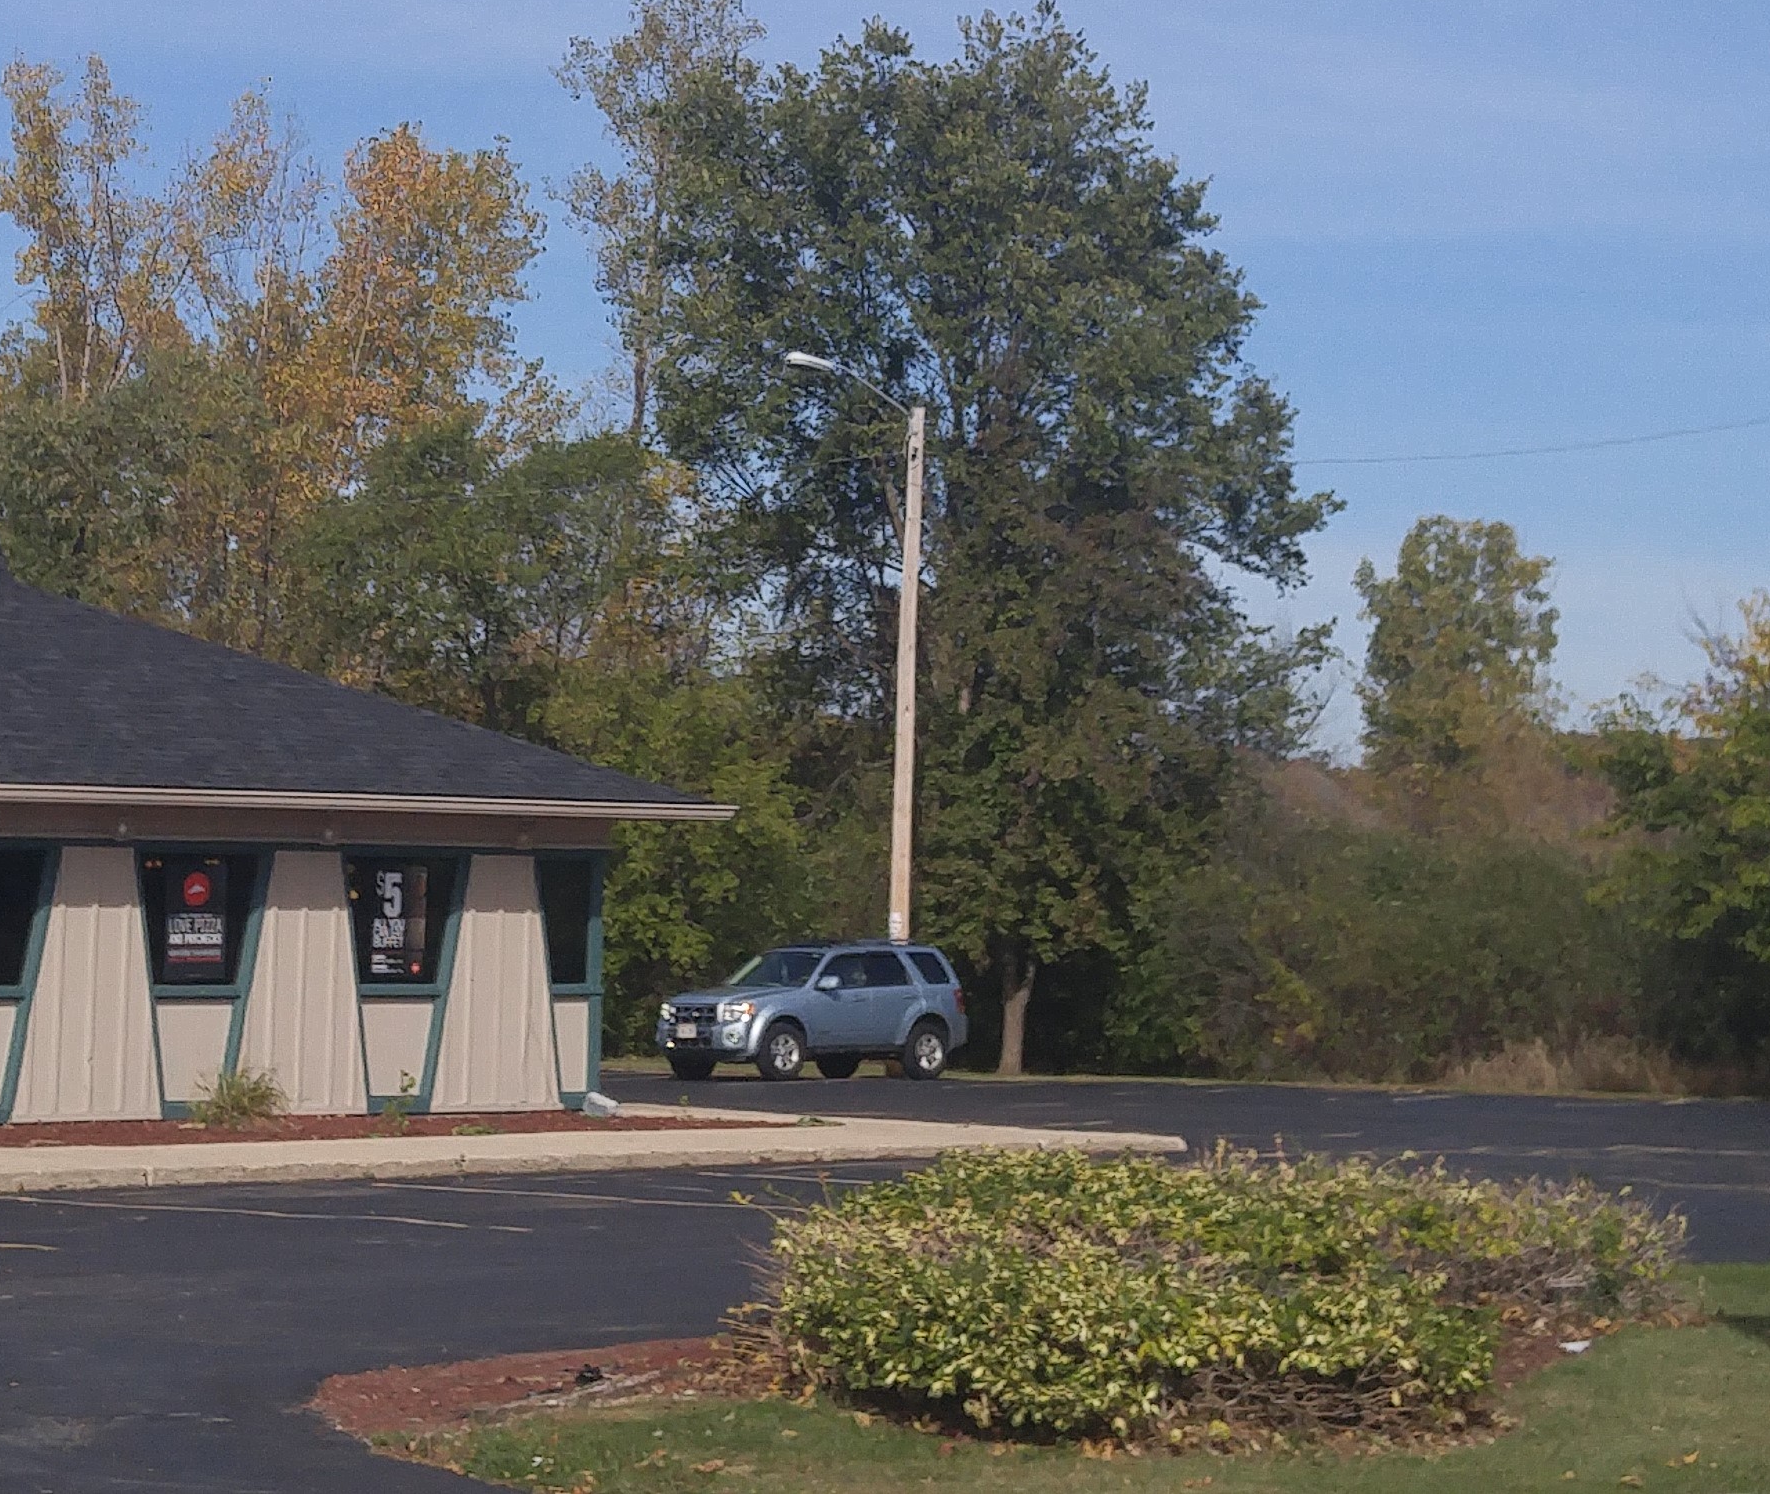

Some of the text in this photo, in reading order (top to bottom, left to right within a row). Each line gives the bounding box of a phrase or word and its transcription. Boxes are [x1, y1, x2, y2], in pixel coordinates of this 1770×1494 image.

[375, 870, 403, 918] $5
[168, 918, 222, 933] LOVE PIZZA
